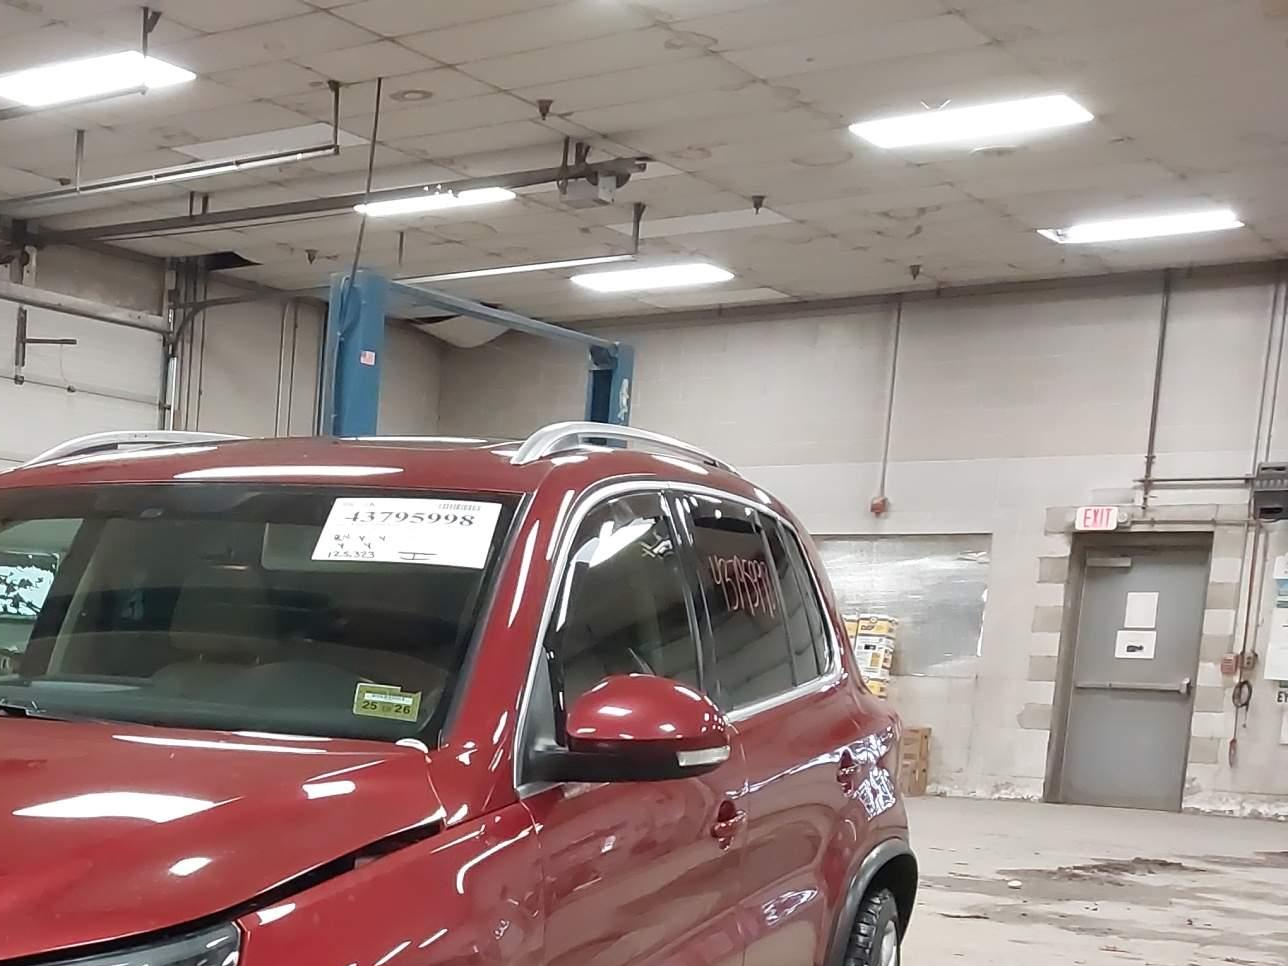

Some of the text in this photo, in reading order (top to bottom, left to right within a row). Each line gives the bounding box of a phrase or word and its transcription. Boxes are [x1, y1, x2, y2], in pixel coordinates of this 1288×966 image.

[344, 511, 475, 526] 43795998
[1083, 508, 1113, 528] EXIT
[361, 701, 378, 711] 25
[394, 704, 411, 715] 26
